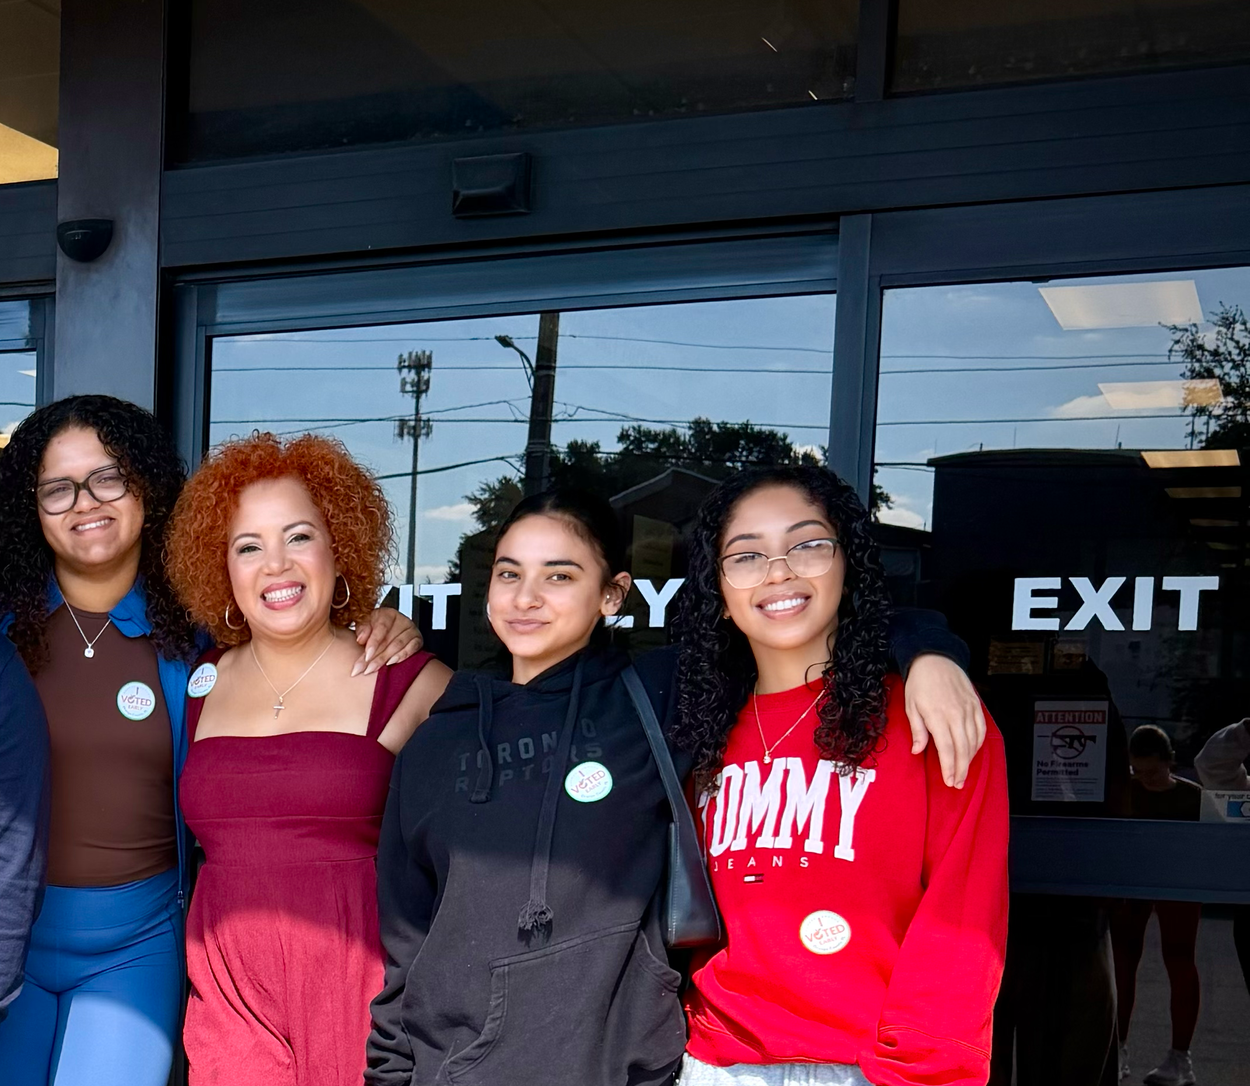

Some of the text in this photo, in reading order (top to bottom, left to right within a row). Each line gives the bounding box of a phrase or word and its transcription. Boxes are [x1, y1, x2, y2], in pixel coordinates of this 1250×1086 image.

[1011, 576, 1220, 631] EXIT
[190, 674, 216, 687] VOTED
[135, 686, 140, 695] I
[121, 694, 152, 707] VOTED
[1036, 711, 1103, 723] ATTENTION
[458, 717, 597, 771] TRONO
[1036, 760, 1089, 768] No Firearms
[1036, 768, 1079, 776] Permitted
[570, 769, 606, 793] VOTED
[698, 757, 877, 862] OMMY
[713, 854, 810, 872] JEANS
[817, 917, 824, 927] I
[804, 924, 846, 943] VOTED
